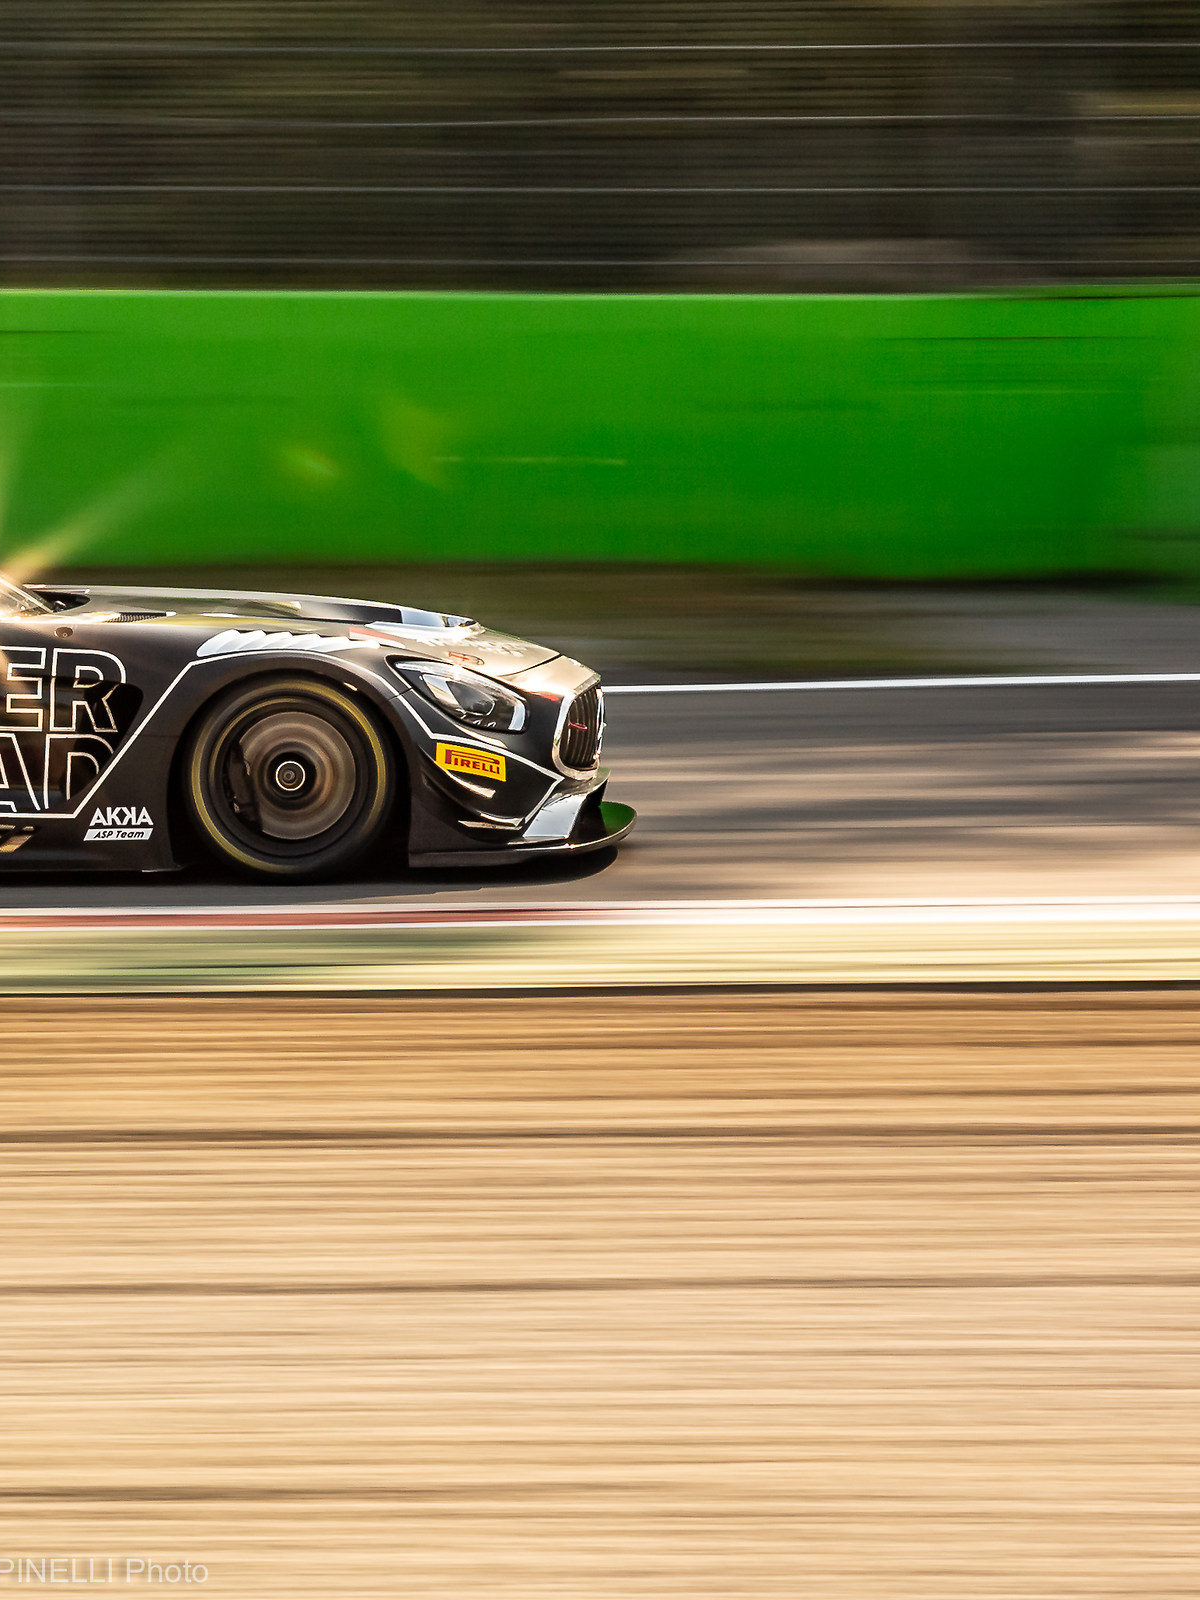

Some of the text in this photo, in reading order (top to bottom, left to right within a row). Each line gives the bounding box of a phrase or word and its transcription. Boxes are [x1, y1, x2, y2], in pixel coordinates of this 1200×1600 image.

[444, 748, 501, 775] PIRELLI
[89, 806, 154, 827] AKKA
[93, 830, 145, 839] ASP Team
